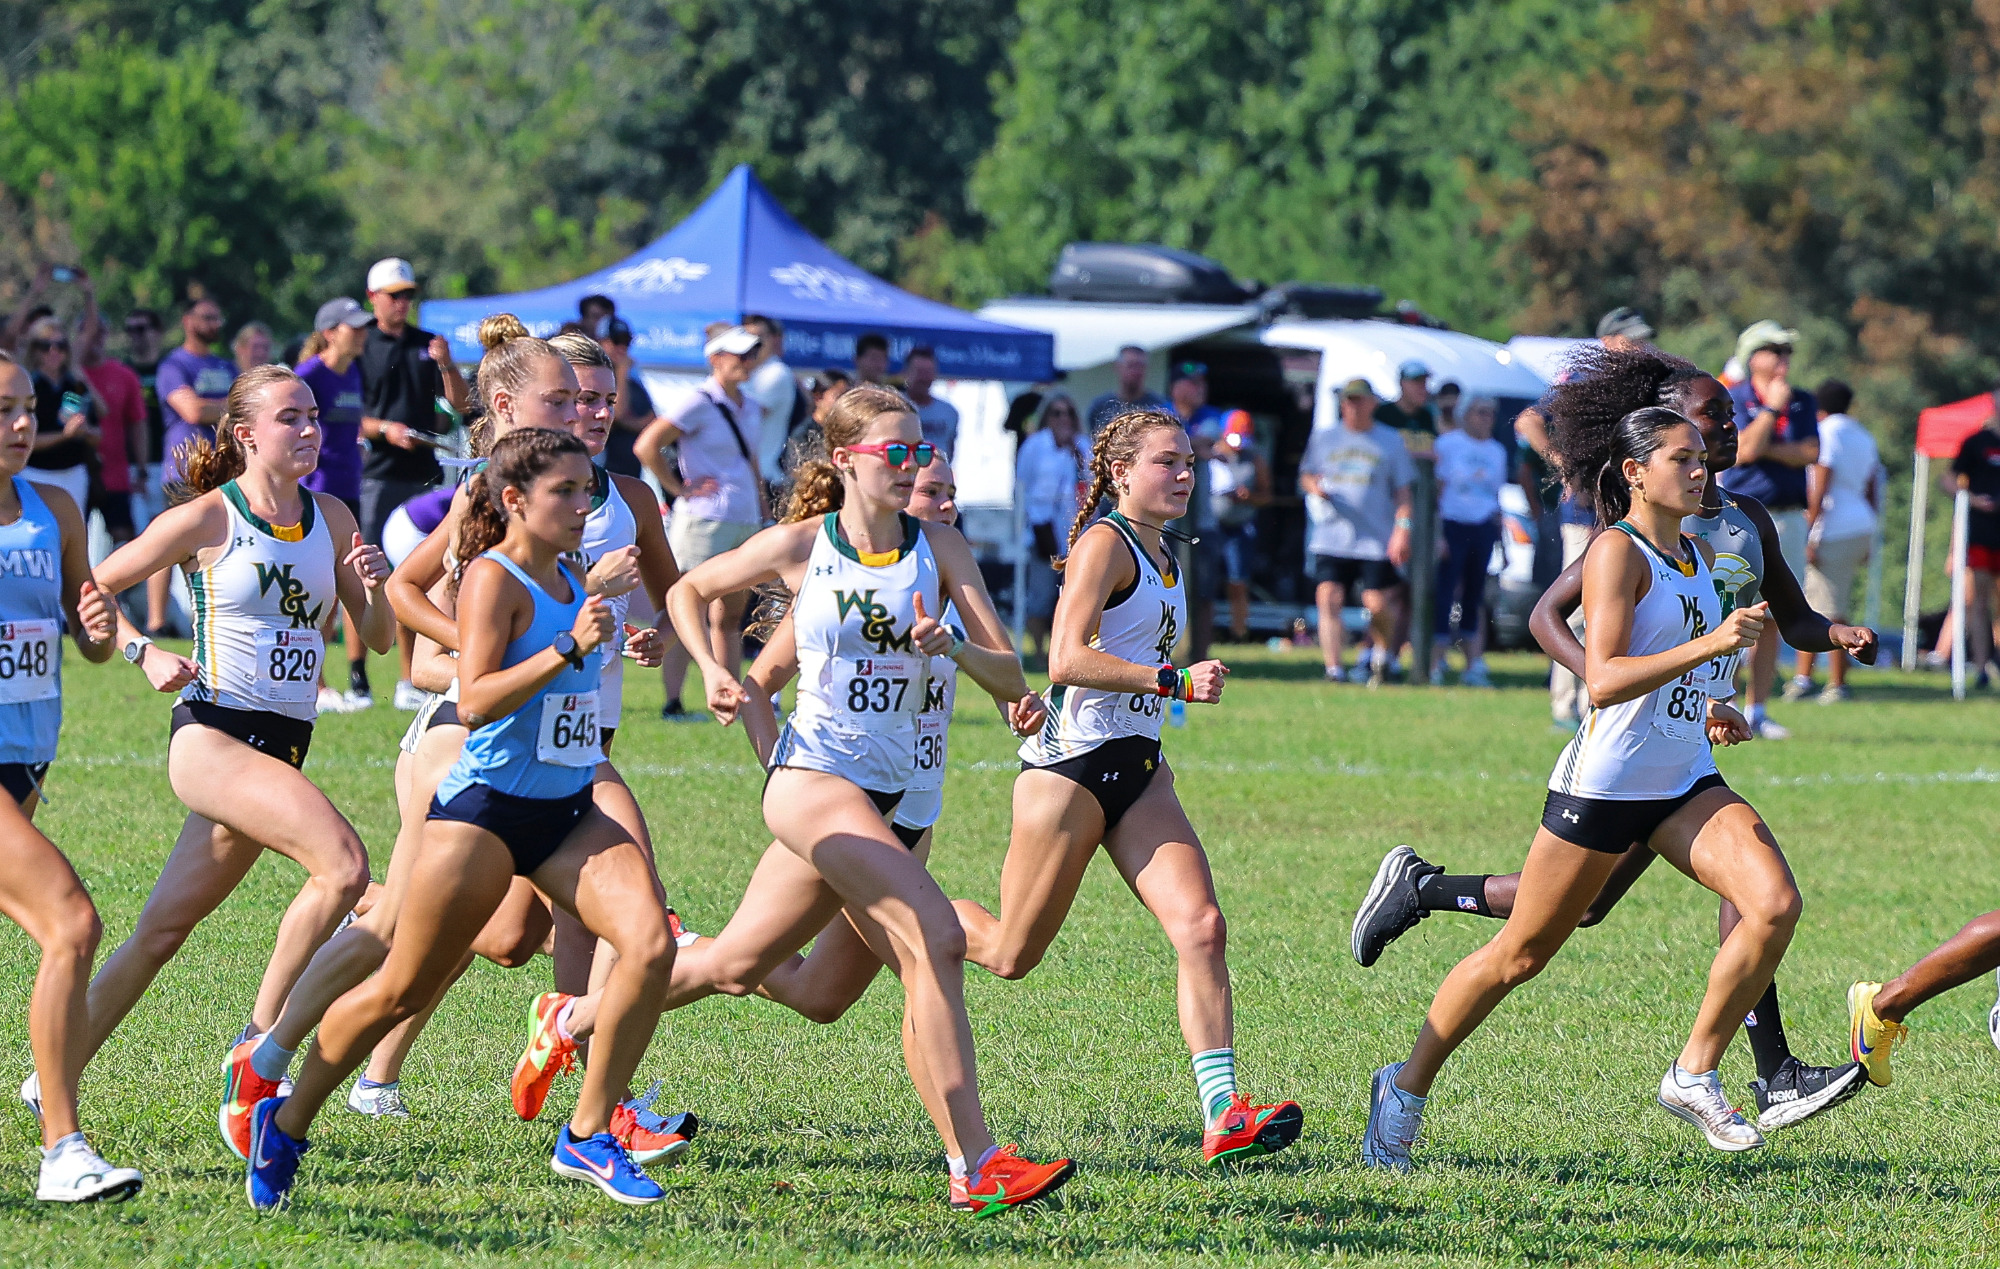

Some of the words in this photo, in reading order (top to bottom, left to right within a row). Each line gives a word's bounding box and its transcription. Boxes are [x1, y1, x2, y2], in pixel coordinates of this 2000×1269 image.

[250, 562, 324, 630] W&M
[832, 588, 914, 655] W&M
[1676, 593, 1707, 641] W&
[0, 640, 48, 679] 648
[269, 647, 317, 682] 829
[847, 677, 910, 713] 837
[1666, 686, 1706, 723] 833
[552, 713, 597, 749] 645
[1767, 1088, 1799, 1104] HOKA
